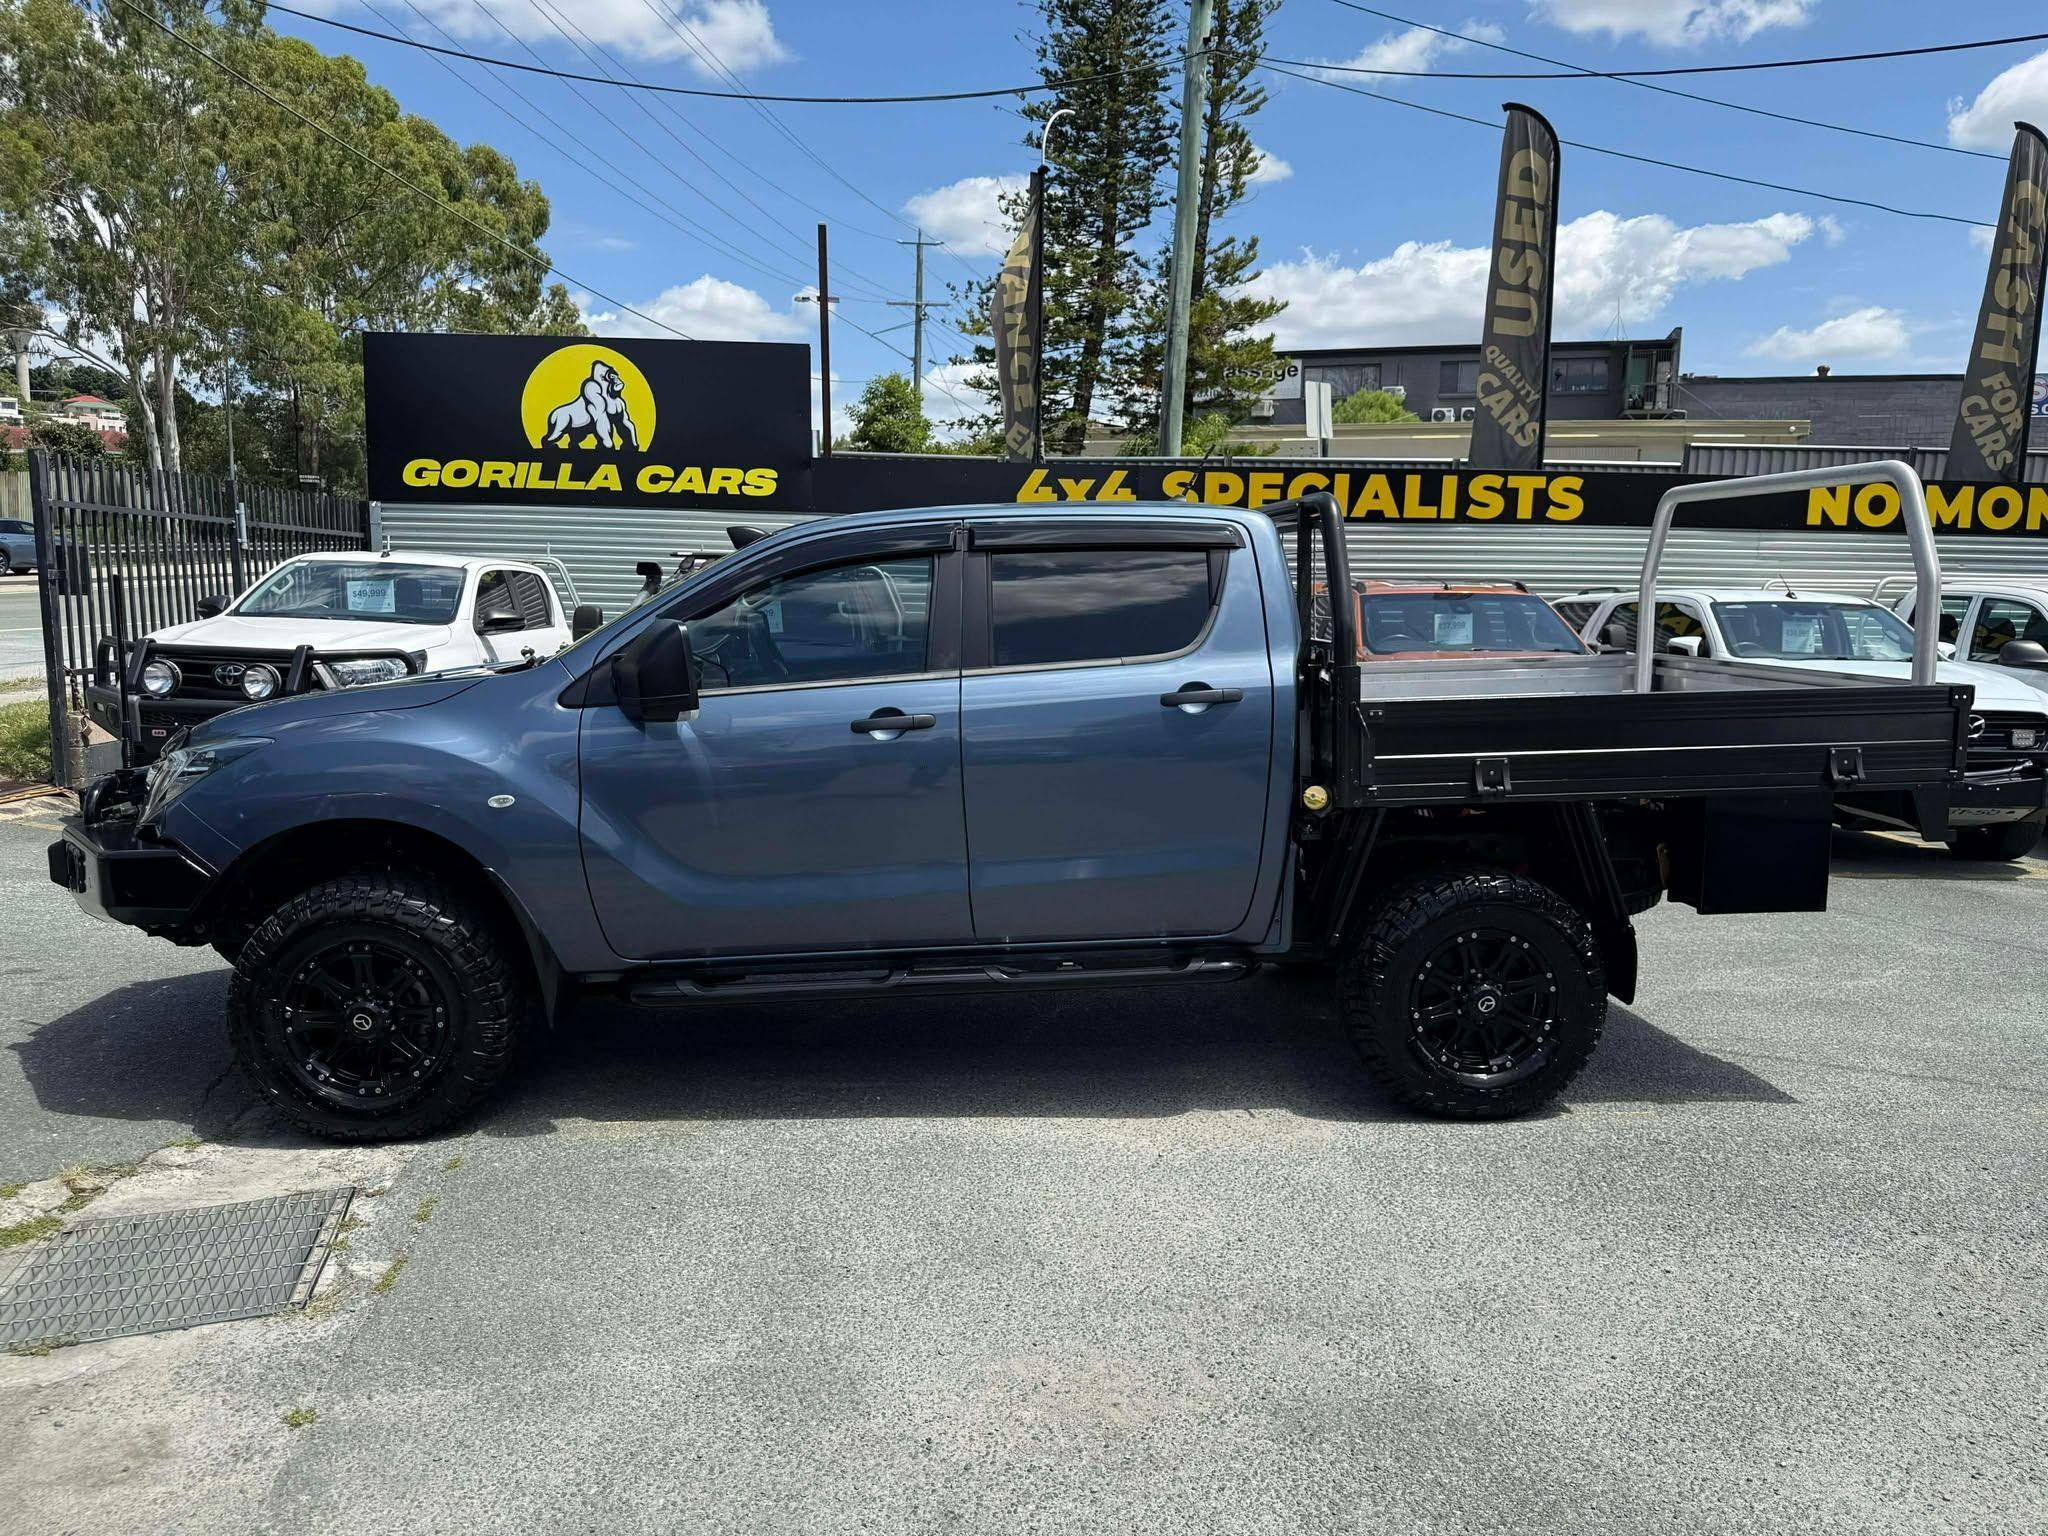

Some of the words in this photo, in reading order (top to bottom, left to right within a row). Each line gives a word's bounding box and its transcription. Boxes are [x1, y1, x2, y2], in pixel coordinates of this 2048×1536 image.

[1493, 149, 1548, 337] USED
[1980, 179, 2046, 367] CASH
[1486, 345, 1541, 404] QUALITY
[1981, 371, 2023, 437] FOR
[1476, 372, 1539, 448] CARS
[1961, 394, 2014, 472] CARS
[402, 458, 623, 492] GORILLA
[636, 464, 778, 497] CARS
[1016, 469, 1137, 503] 4x4
[1162, 470, 1584, 521] SPECIALISTS
[1806, 482, 1901, 528] NO
